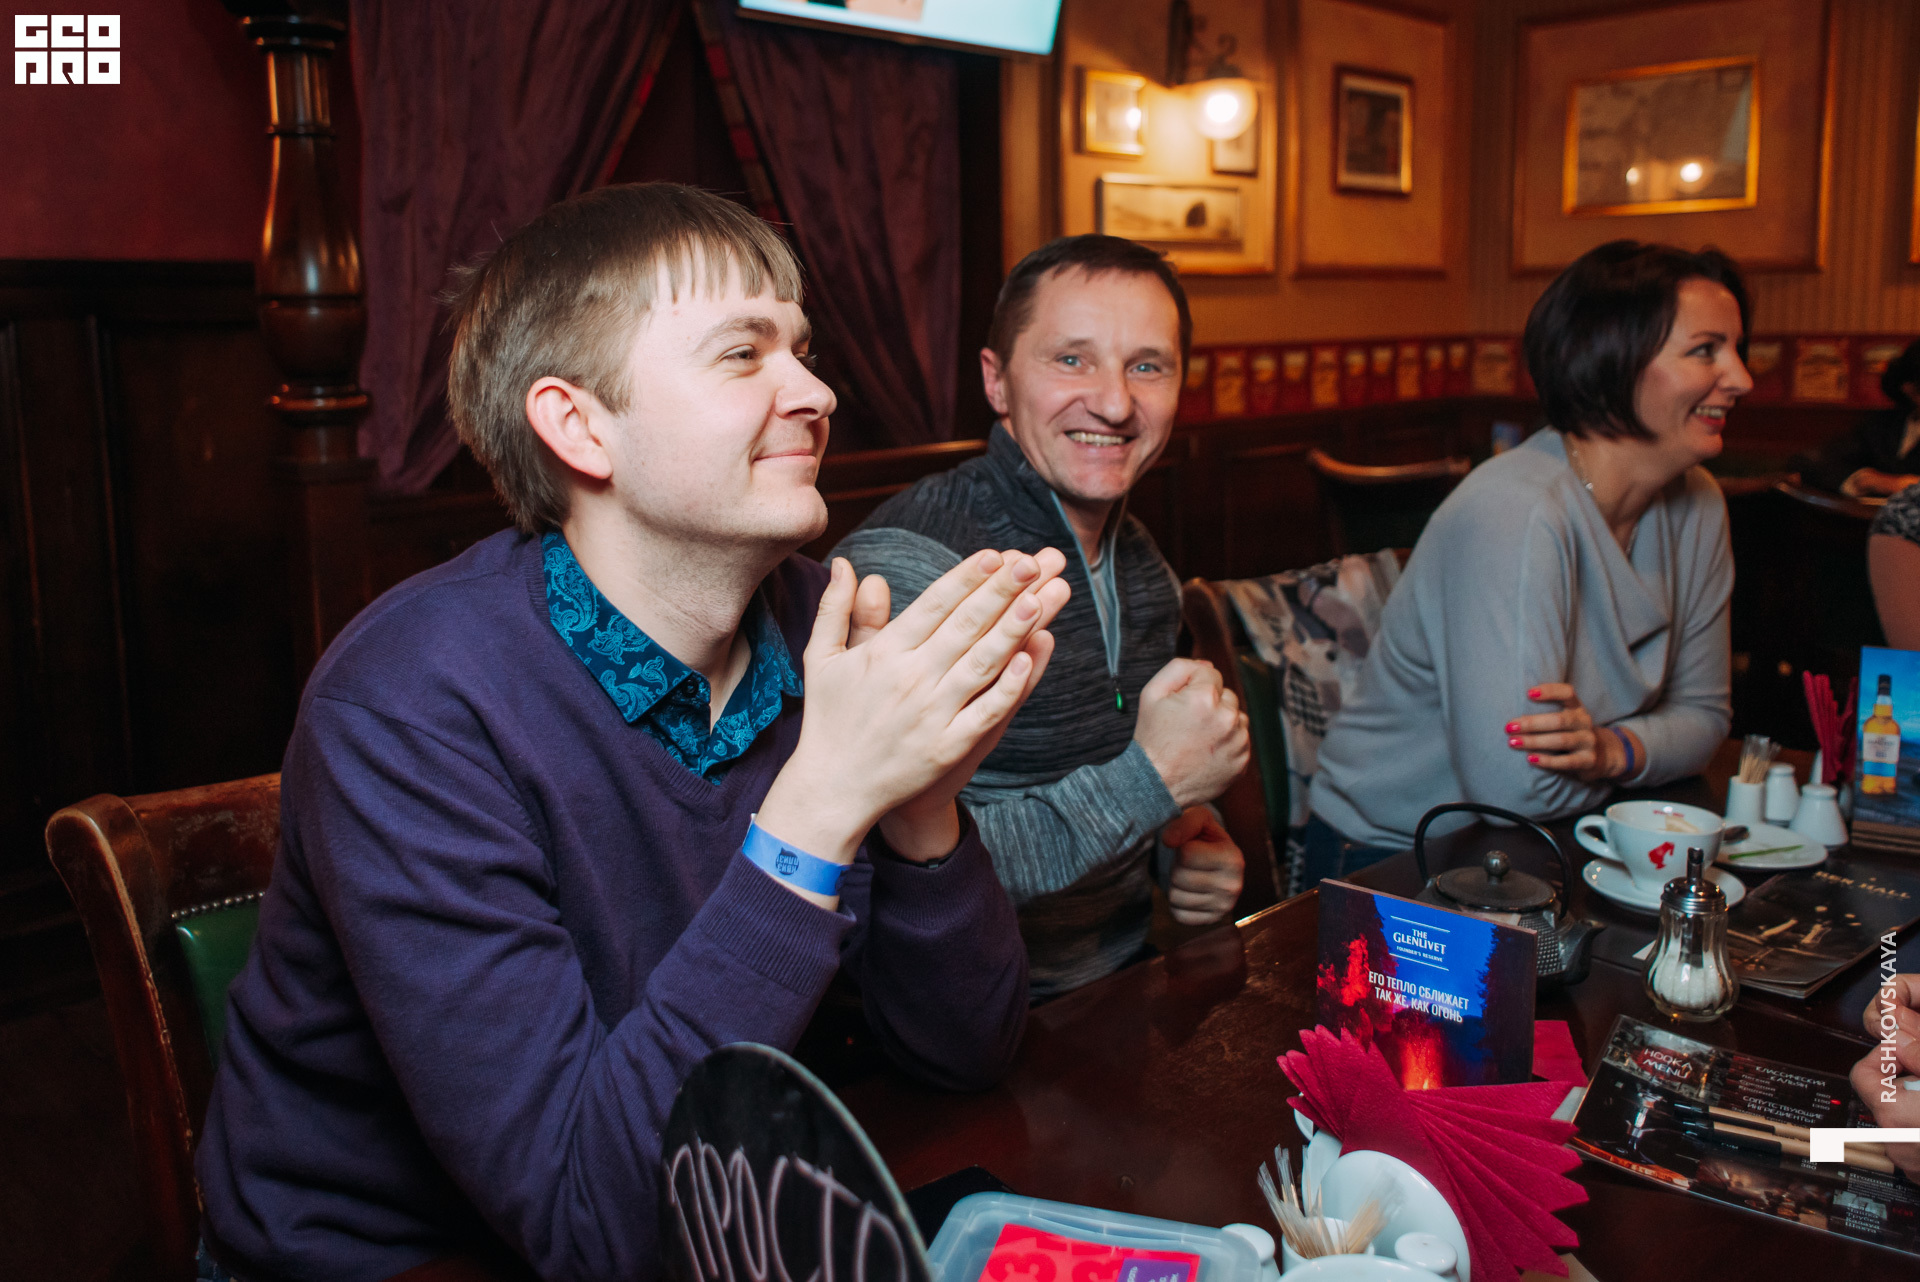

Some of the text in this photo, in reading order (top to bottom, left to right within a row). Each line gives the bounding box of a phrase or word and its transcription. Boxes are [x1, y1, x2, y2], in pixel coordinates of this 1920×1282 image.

[1393, 931, 1446, 954] GLENLIVET
[1411, 928, 1428, 940] THE
[1422, 951, 1443, 963] RESERVE
[1368, 970, 1469, 1011] ЕГО ТЕПЛО СБЛИЖАЕТ
[1374, 986, 1463, 1024] ТАК ЖЕ, КАК ОГОНЬ
[1643, 1058, 1692, 1079] MENU
[1755, 1065, 1826, 1087] КЛАССИЧЕСКИЙ
[1769, 1075, 1809, 1090] КАЛЬЯН
[1742, 1095, 1825, 1120] СОПУТСТВУЮЩИЕ
